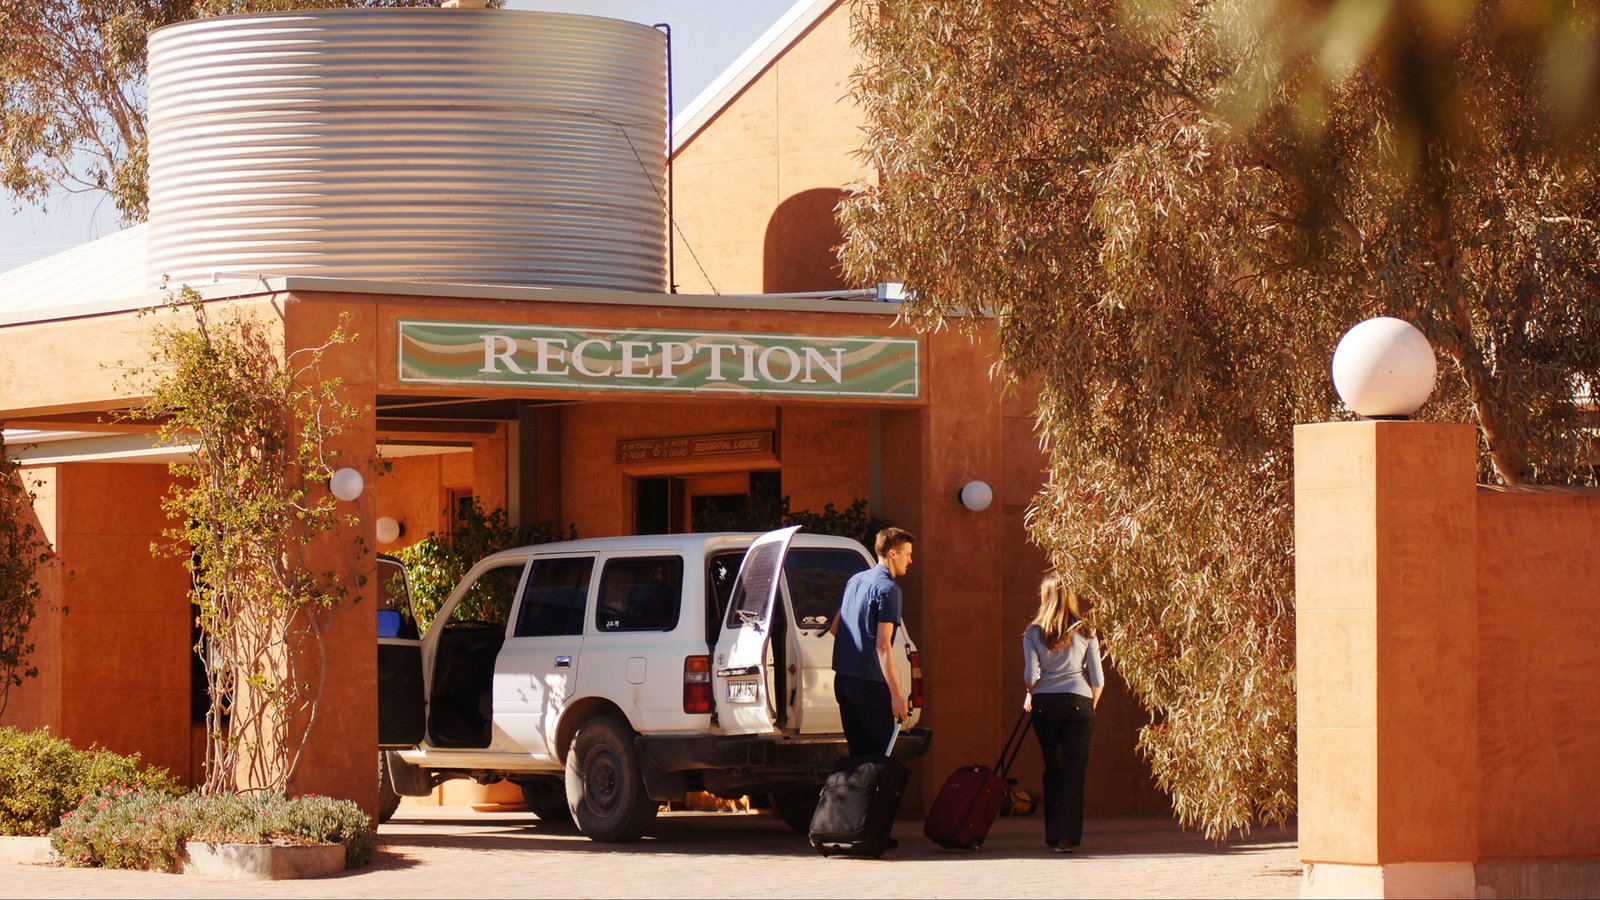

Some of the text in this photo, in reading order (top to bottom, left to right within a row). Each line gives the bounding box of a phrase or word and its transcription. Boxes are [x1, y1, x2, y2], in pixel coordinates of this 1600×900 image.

[478, 335, 846, 383] RECEPTION
[694, 438, 761, 452] RESIDENTIAL LICENCE
